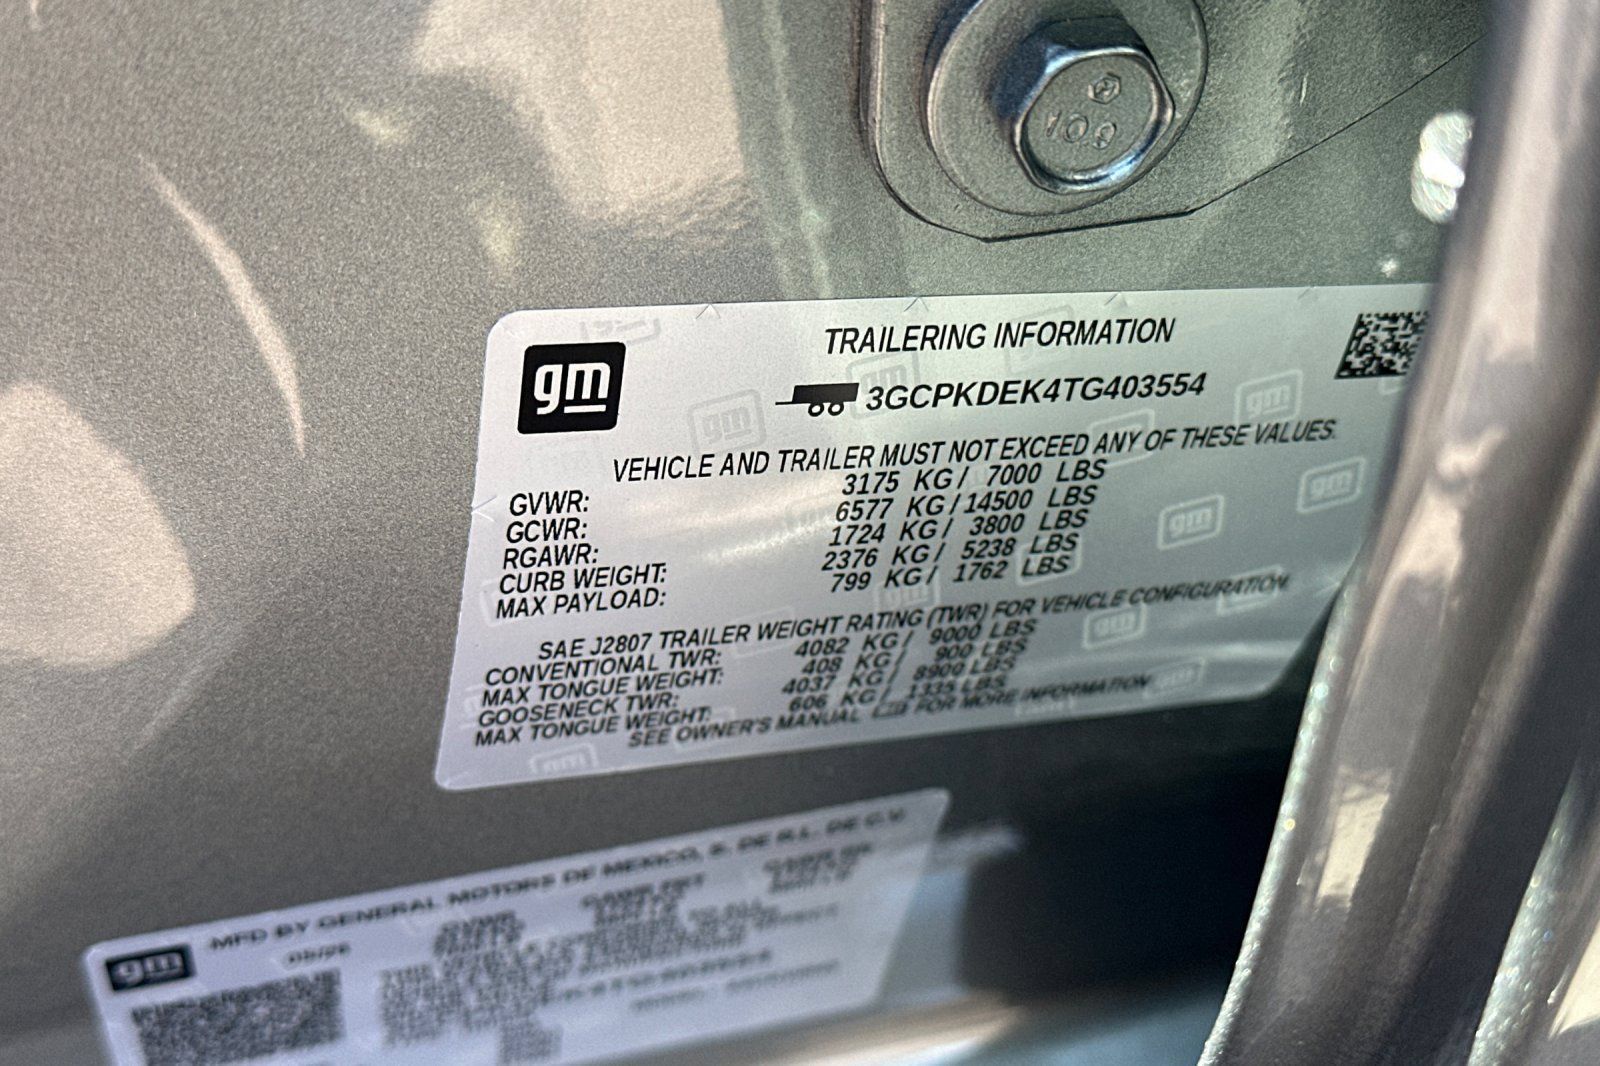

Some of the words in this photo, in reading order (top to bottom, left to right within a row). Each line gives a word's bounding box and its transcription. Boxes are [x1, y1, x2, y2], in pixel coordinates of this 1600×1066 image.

[825, 323, 987, 355] TRAILERING
[993, 317, 1176, 349] INFORMATION
[533, 361, 611, 416] gm
[865, 371, 1207, 411] 3GCPKDEK4TG403554
[1246, 385, 1291, 420] gm
[613, 453, 716, 483] VEHICLE
[718, 450, 770, 478] AND
[777, 444, 876, 473] TRAILER
[879, 440, 946, 468] MUST
[948, 437, 999, 464] NOT
[999, 432, 1089, 461] EXCEED
[1093, 429, 1142, 455] ANY
[1144, 427, 1177, 451] OF
[1180, 423, 1251, 450] THESE
[1254, 418, 1338, 444] VALUES.
[700, 406, 751, 444] gm
[506, 517, 588, 543] GCWR:
[836, 497, 894, 522] 6577
[1047, 484, 1099, 508] LBS
[509, 489, 590, 516] GVWR:
[841, 470, 900, 496] 3175
[986, 462, 1042, 487] 7000
[1056, 458, 1107, 482] LBS
[1309, 470, 1354, 501] gm
[503, 543, 600, 570] RGAWR:
[828, 522, 887, 547] 1724
[969, 512, 1026, 536] 3800
[1038, 508, 1090, 531] LBS
[1168, 507, 1213, 540] gm
[496, 594, 546, 620] MAX
[553, 586, 667, 615] PAYLOAD:
[831, 571, 872, 593] 799
[953, 560, 1009, 583] 1762
[1021, 554, 1072, 577] LBS
[499, 569, 565, 595] CURB
[573, 562, 667, 590] WEIGHT:
[822, 547, 879, 572] 2376
[961, 537, 1016, 561] 5238
[1029, 532, 1080, 555] LBS
[538, 638, 587, 661] SAE
[590, 633, 653, 656] J2807
[659, 624, 751, 650] TRAILER
[757, 614, 845, 641] WEIGHT
[845, 608, 925, 633] RATING
[926, 602, 989, 629] (TWR)
[992, 598, 1037, 619] FOR
[1041, 587, 1130, 614] VEHICLE
[1129, 573, 1290, 606] CONFIGURATION
[482, 686, 531, 708] MAX
[538, 676, 631, 702] TONGUE
[635, 667, 725, 692] WEIGHT:
[801, 656, 844, 675] 408
[934, 643, 974, 662] 900
[980, 637, 1030, 658] LBS
[486, 653, 660, 687] CONVENTIONAL
[668, 647, 722, 669] TWR:
[794, 636, 851, 657] 4082
[928, 625, 983, 645] 9000
[988, 618, 1039, 639] LBS
[475, 726, 523, 748] MAX
[530, 715, 622, 742] TONGUE
[625, 705, 714, 731] WEIGHT:
[788, 694, 829, 713] 606
[907, 679, 957, 699] 1335
[961, 674, 1008, 694] LBS
[478, 696, 621, 729] GOOSENECK
[625, 691, 680, 712] TWR:
[781, 675, 838, 695] 4037
[911, 662, 966, 682] 8900
[968, 656, 1018, 676] LBS
[628, 727, 671, 749] SEE
[675, 716, 773, 744] OWNER'S
[774, 709, 862, 732] MANUAL
[914, 694, 957, 714] FOR
[959, 688, 1018, 709] MORE
[315, 895, 434, 931] GENERAL
[447, 872, 557, 905] MOTORS
